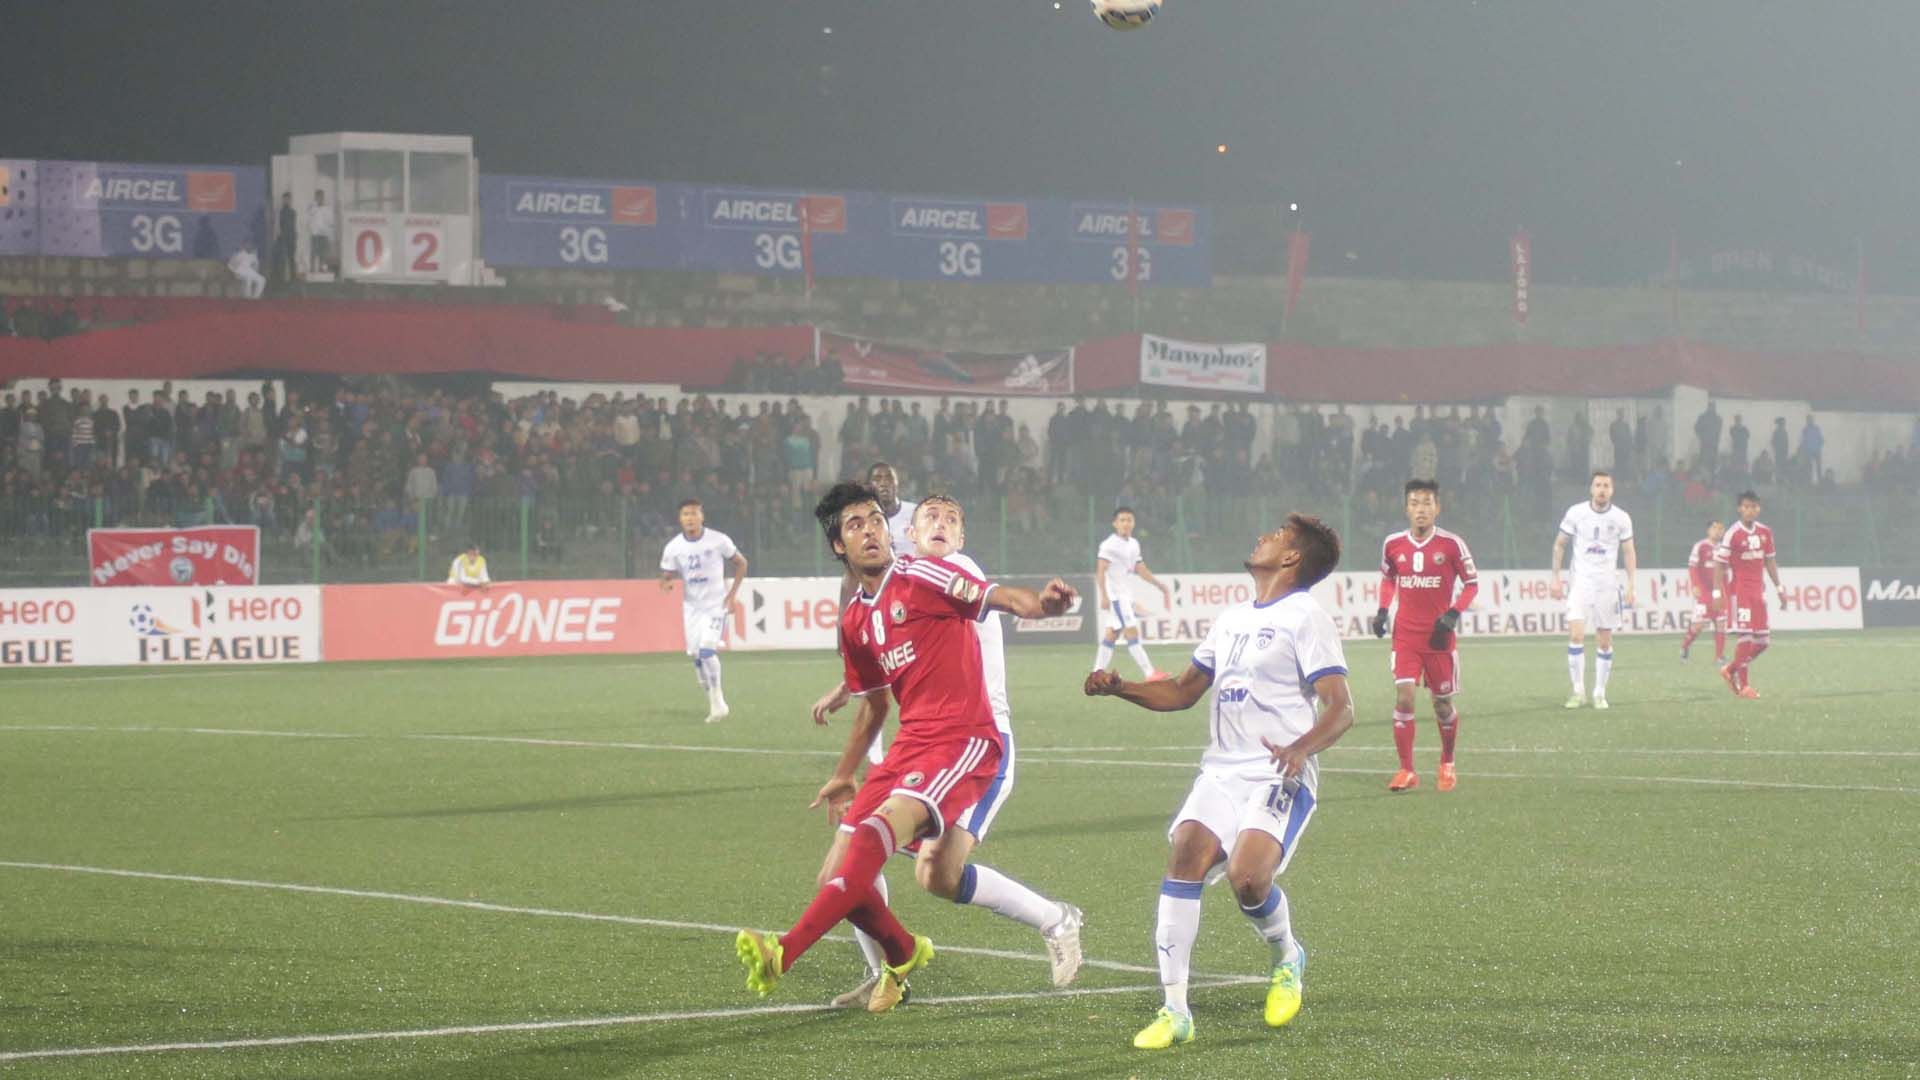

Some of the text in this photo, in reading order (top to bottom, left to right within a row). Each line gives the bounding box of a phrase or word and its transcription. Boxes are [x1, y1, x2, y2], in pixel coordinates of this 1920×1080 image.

[84, 178, 180, 200] AIRCEL
[516, 192, 606, 214] AIRCEL
[713, 200, 799, 222] AIRCEL
[901, 208, 981, 230] AIRCEL
[1078, 214, 1152, 235] AIRCL
[131, 214, 183, 252] 3G
[560, 227, 608, 263] 3G
[356, 229, 439, 271] 0 2
[756, 233, 802, 269] 3G
[939, 241, 982, 276] 3G
[94, 536, 254, 584] Never Say Die
[1191, 583, 1250, 606] Hero
[0, 600, 75, 624] Hero
[228, 597, 302, 621] Hero
[783, 598, 838, 630] He
[872, 610, 885, 645] 8
[138, 636, 300, 662] I-LEAGUE
[879, 641, 916, 676] NEE
[1219, 687, 1248, 702] SW
[1266, 784, 1293, 814] 13
